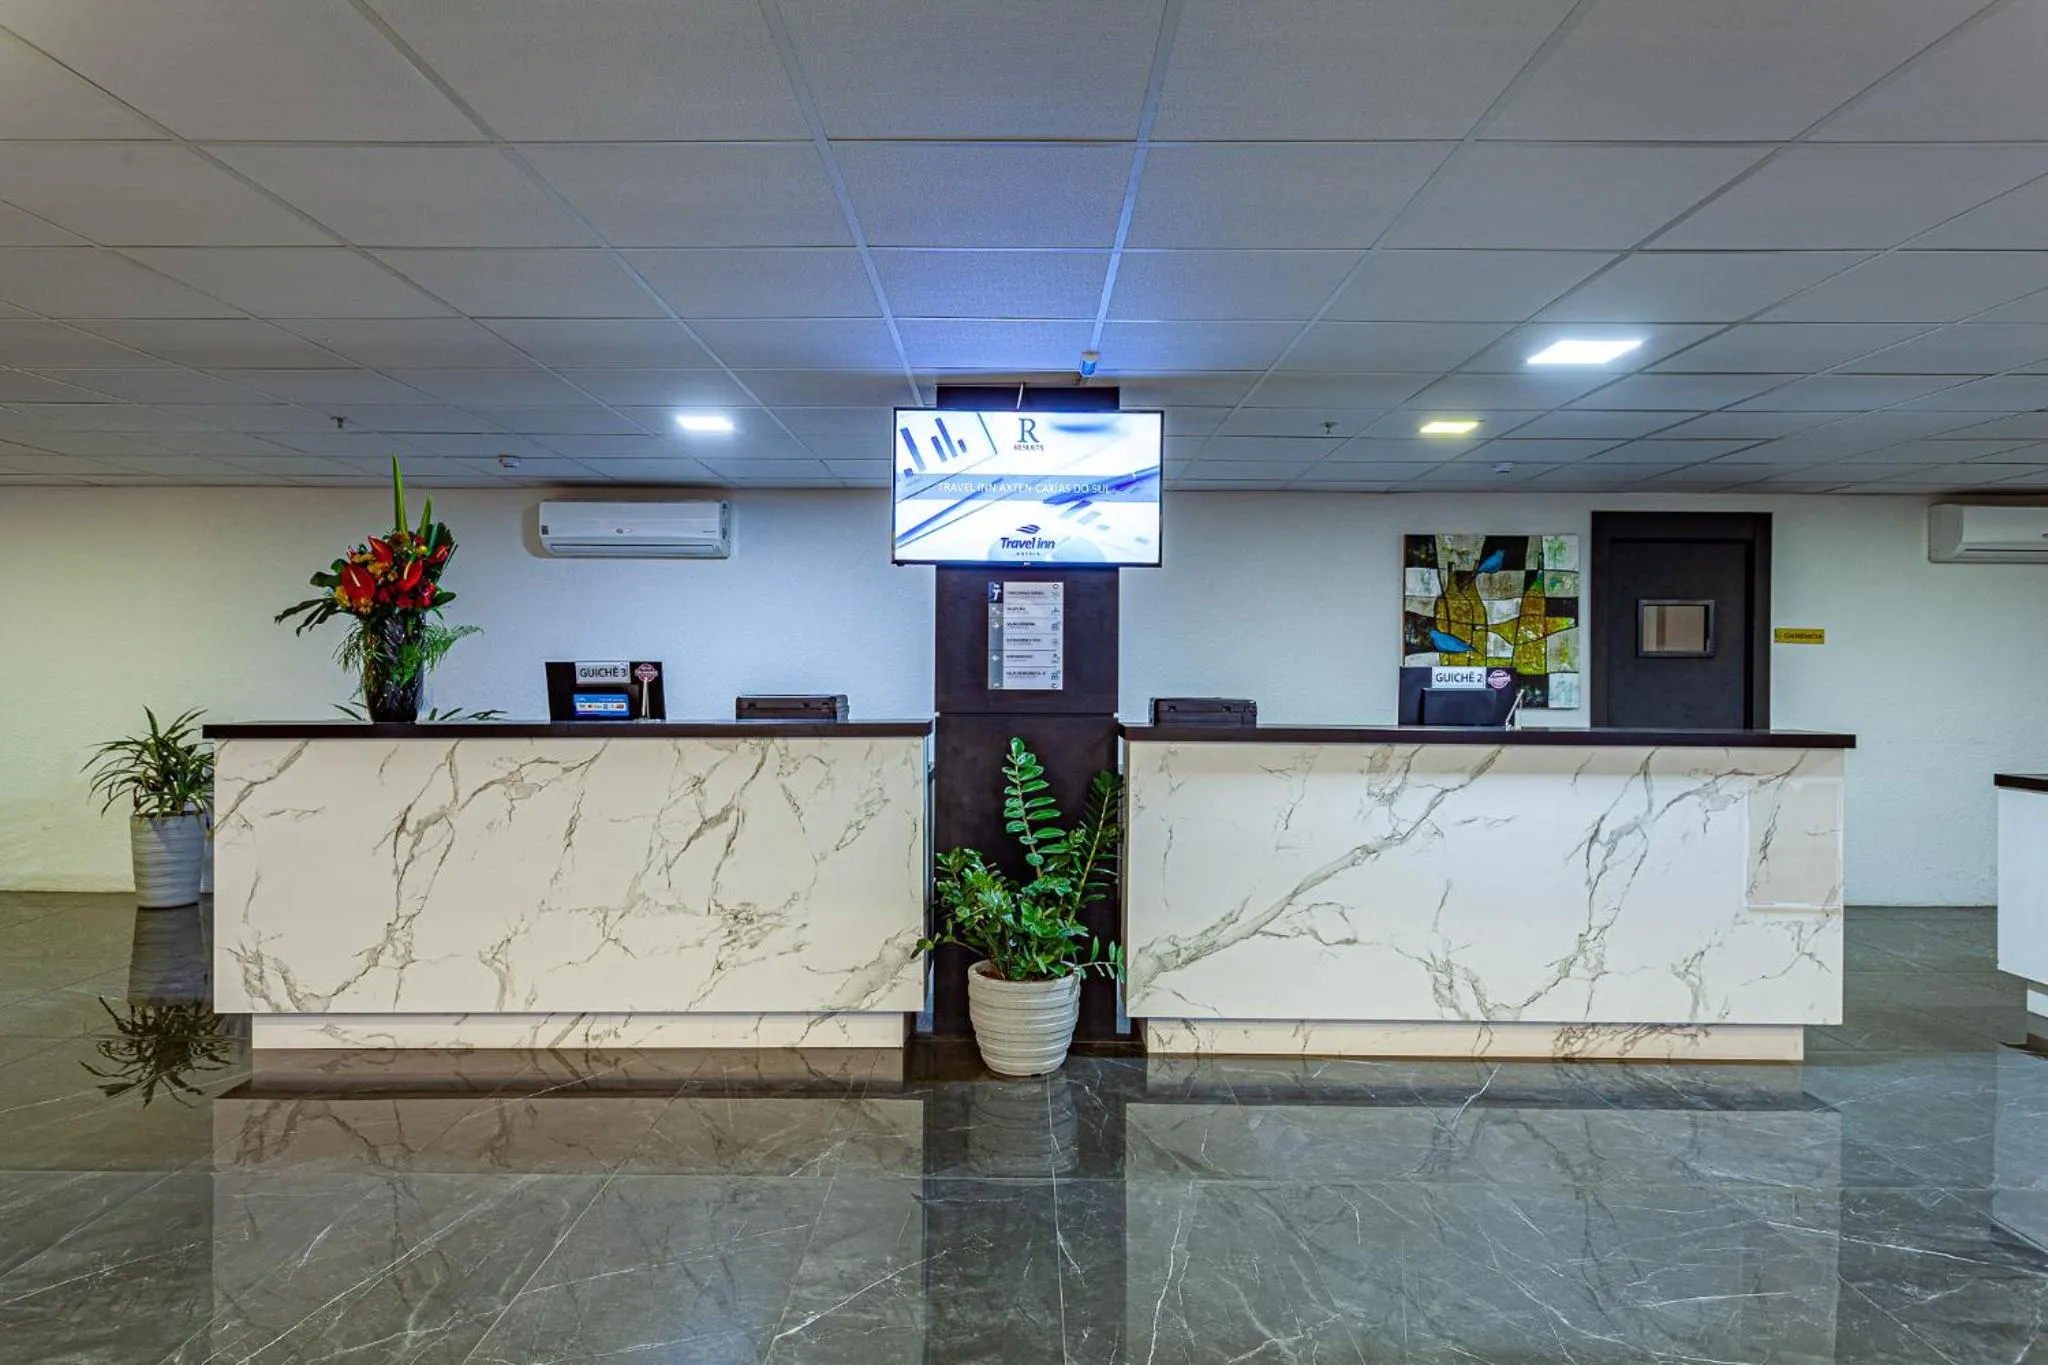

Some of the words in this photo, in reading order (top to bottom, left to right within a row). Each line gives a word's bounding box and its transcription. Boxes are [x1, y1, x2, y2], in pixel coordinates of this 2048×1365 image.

[1017, 417, 1040, 443] R
[936, 482, 974, 494] TRAVEL
[976, 482, 997, 494] INN
[1073, 483, 1089, 494] DO
[1092, 483, 1109, 495] SUL
[1000, 537, 1036, 549] Travel
[1037, 537, 1056, 549] inn
[619, 668, 627, 678] 3
[1435, 671, 1475, 683] GUICHÊ
[1476, 673, 1484, 683] 2
